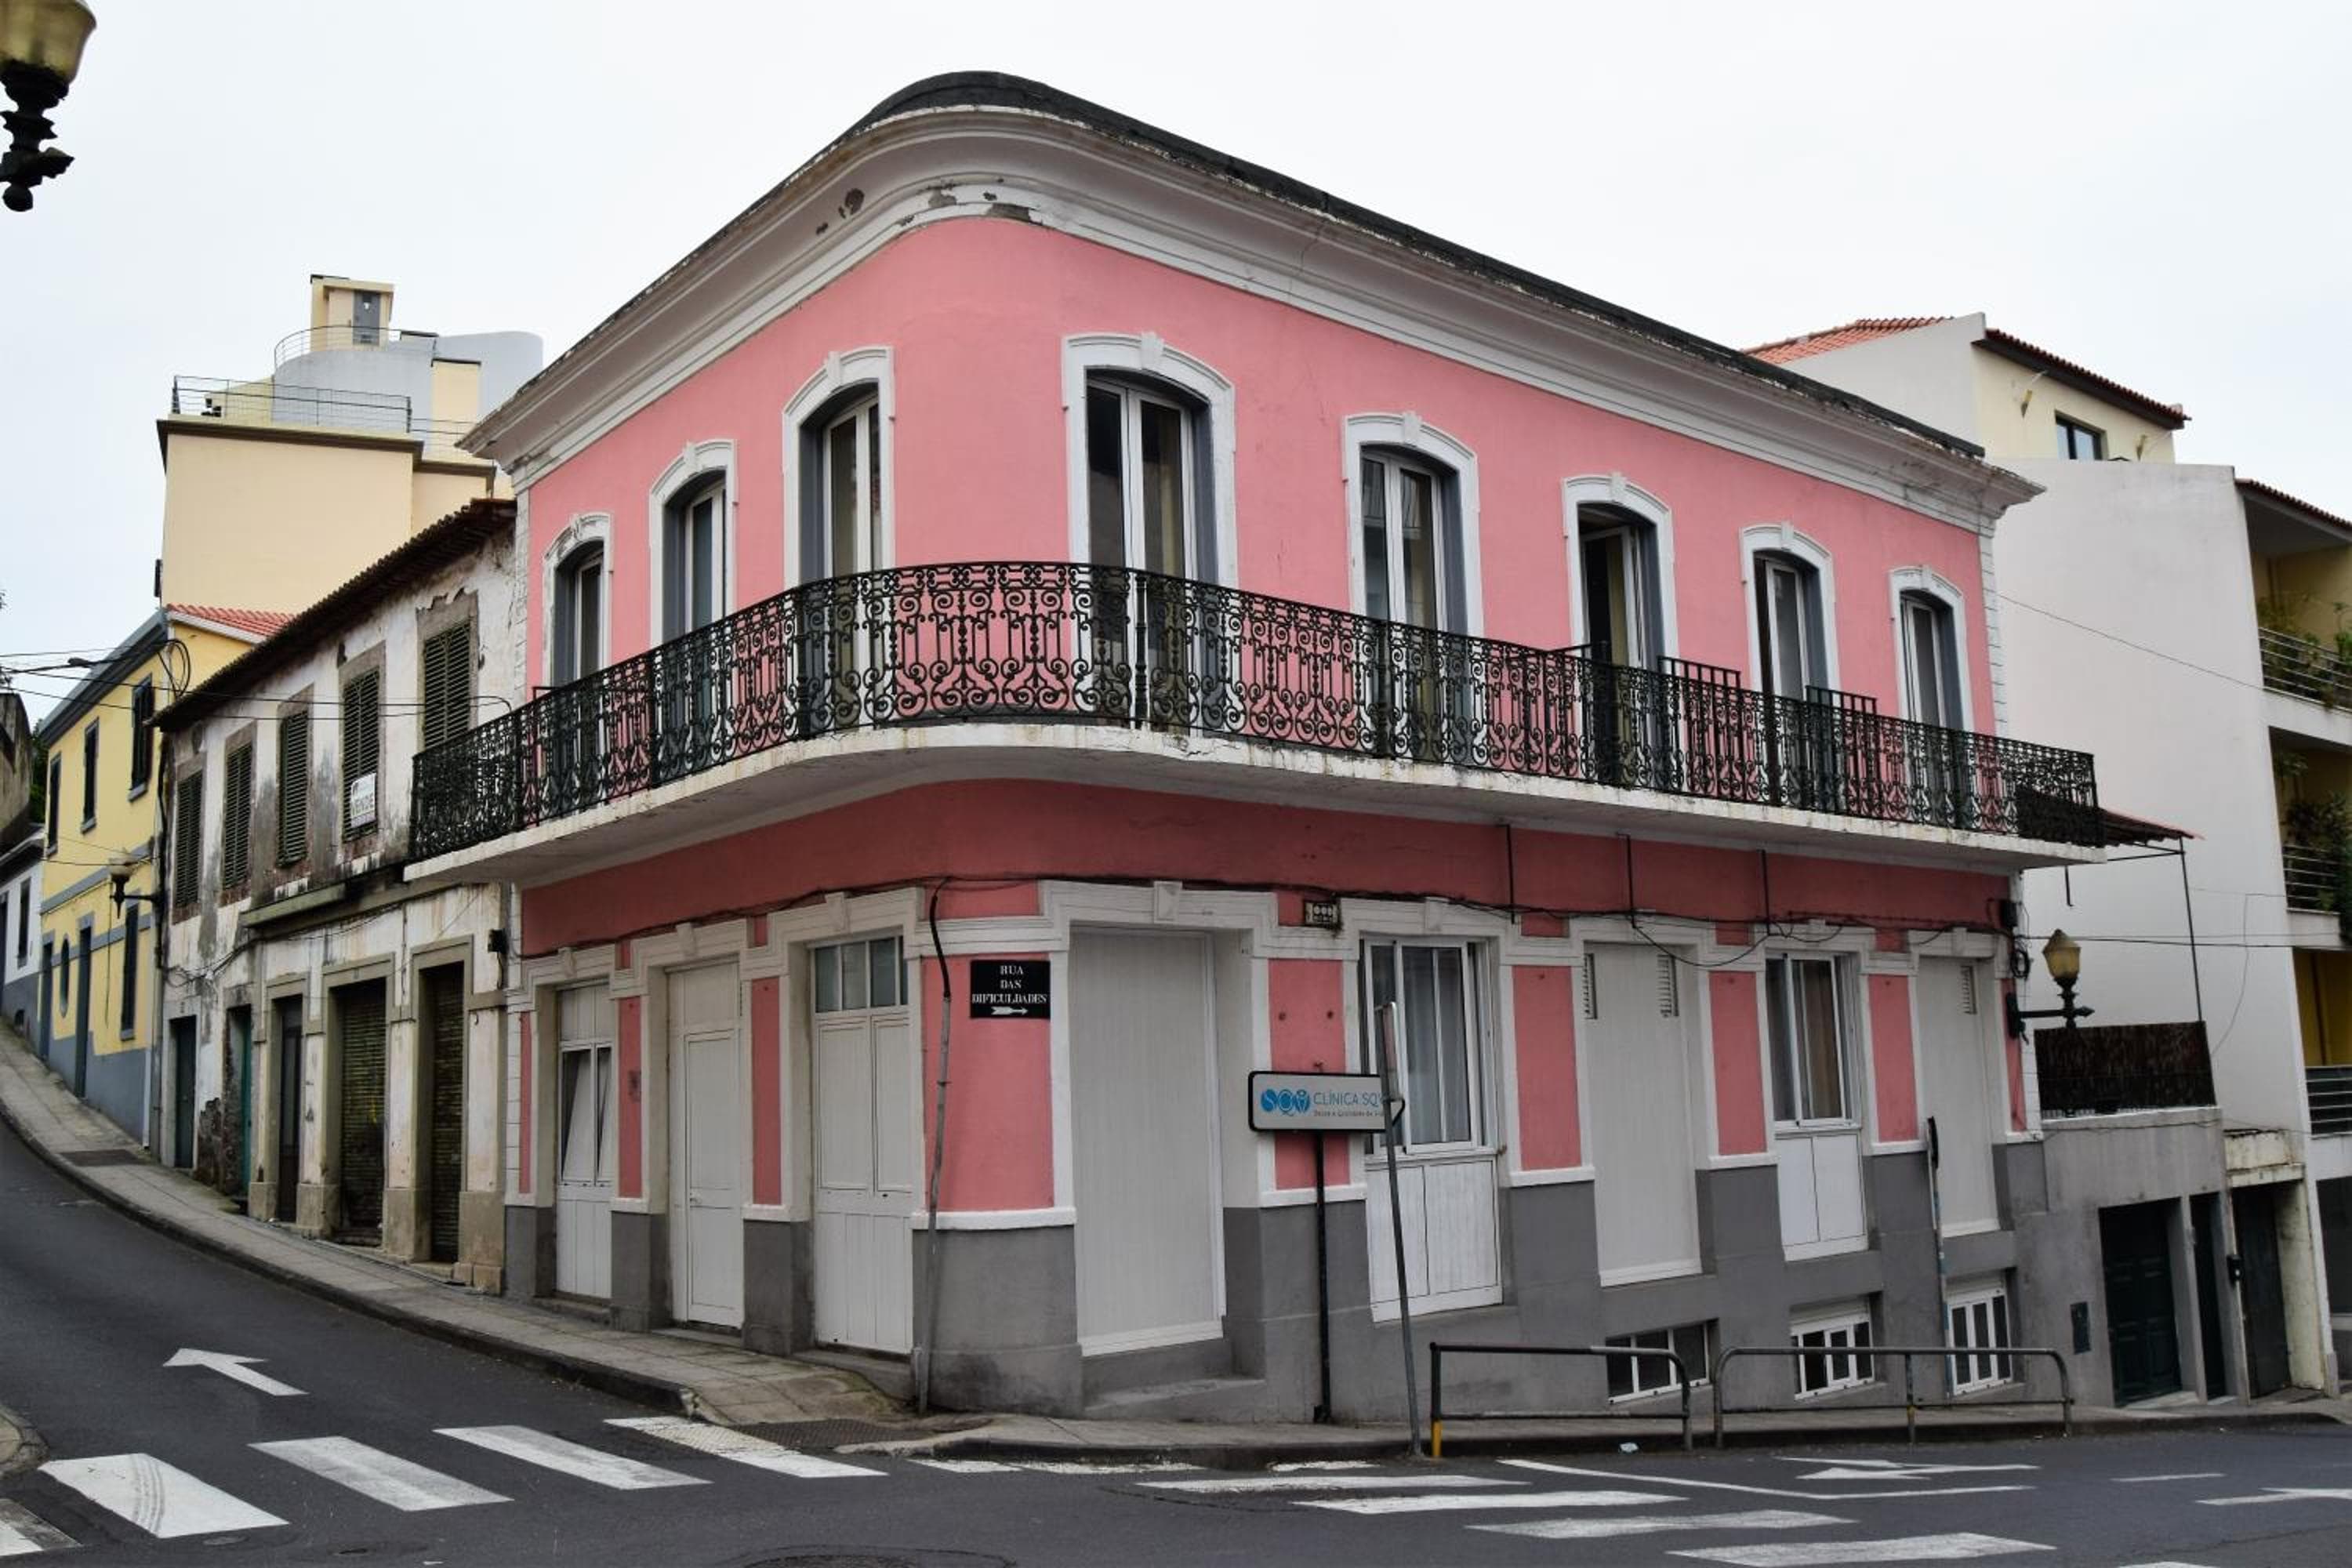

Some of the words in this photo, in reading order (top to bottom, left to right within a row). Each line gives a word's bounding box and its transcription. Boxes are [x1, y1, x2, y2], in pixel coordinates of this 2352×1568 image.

[1000, 965, 1023, 975] RUA
[1000, 979, 1022, 989] DAS
[972, 993, 1047, 1004] DIFICULDADES
[1313, 1090, 1358, 1105] CLÍNICA
[1362, 1091, 1381, 1107] SQ
